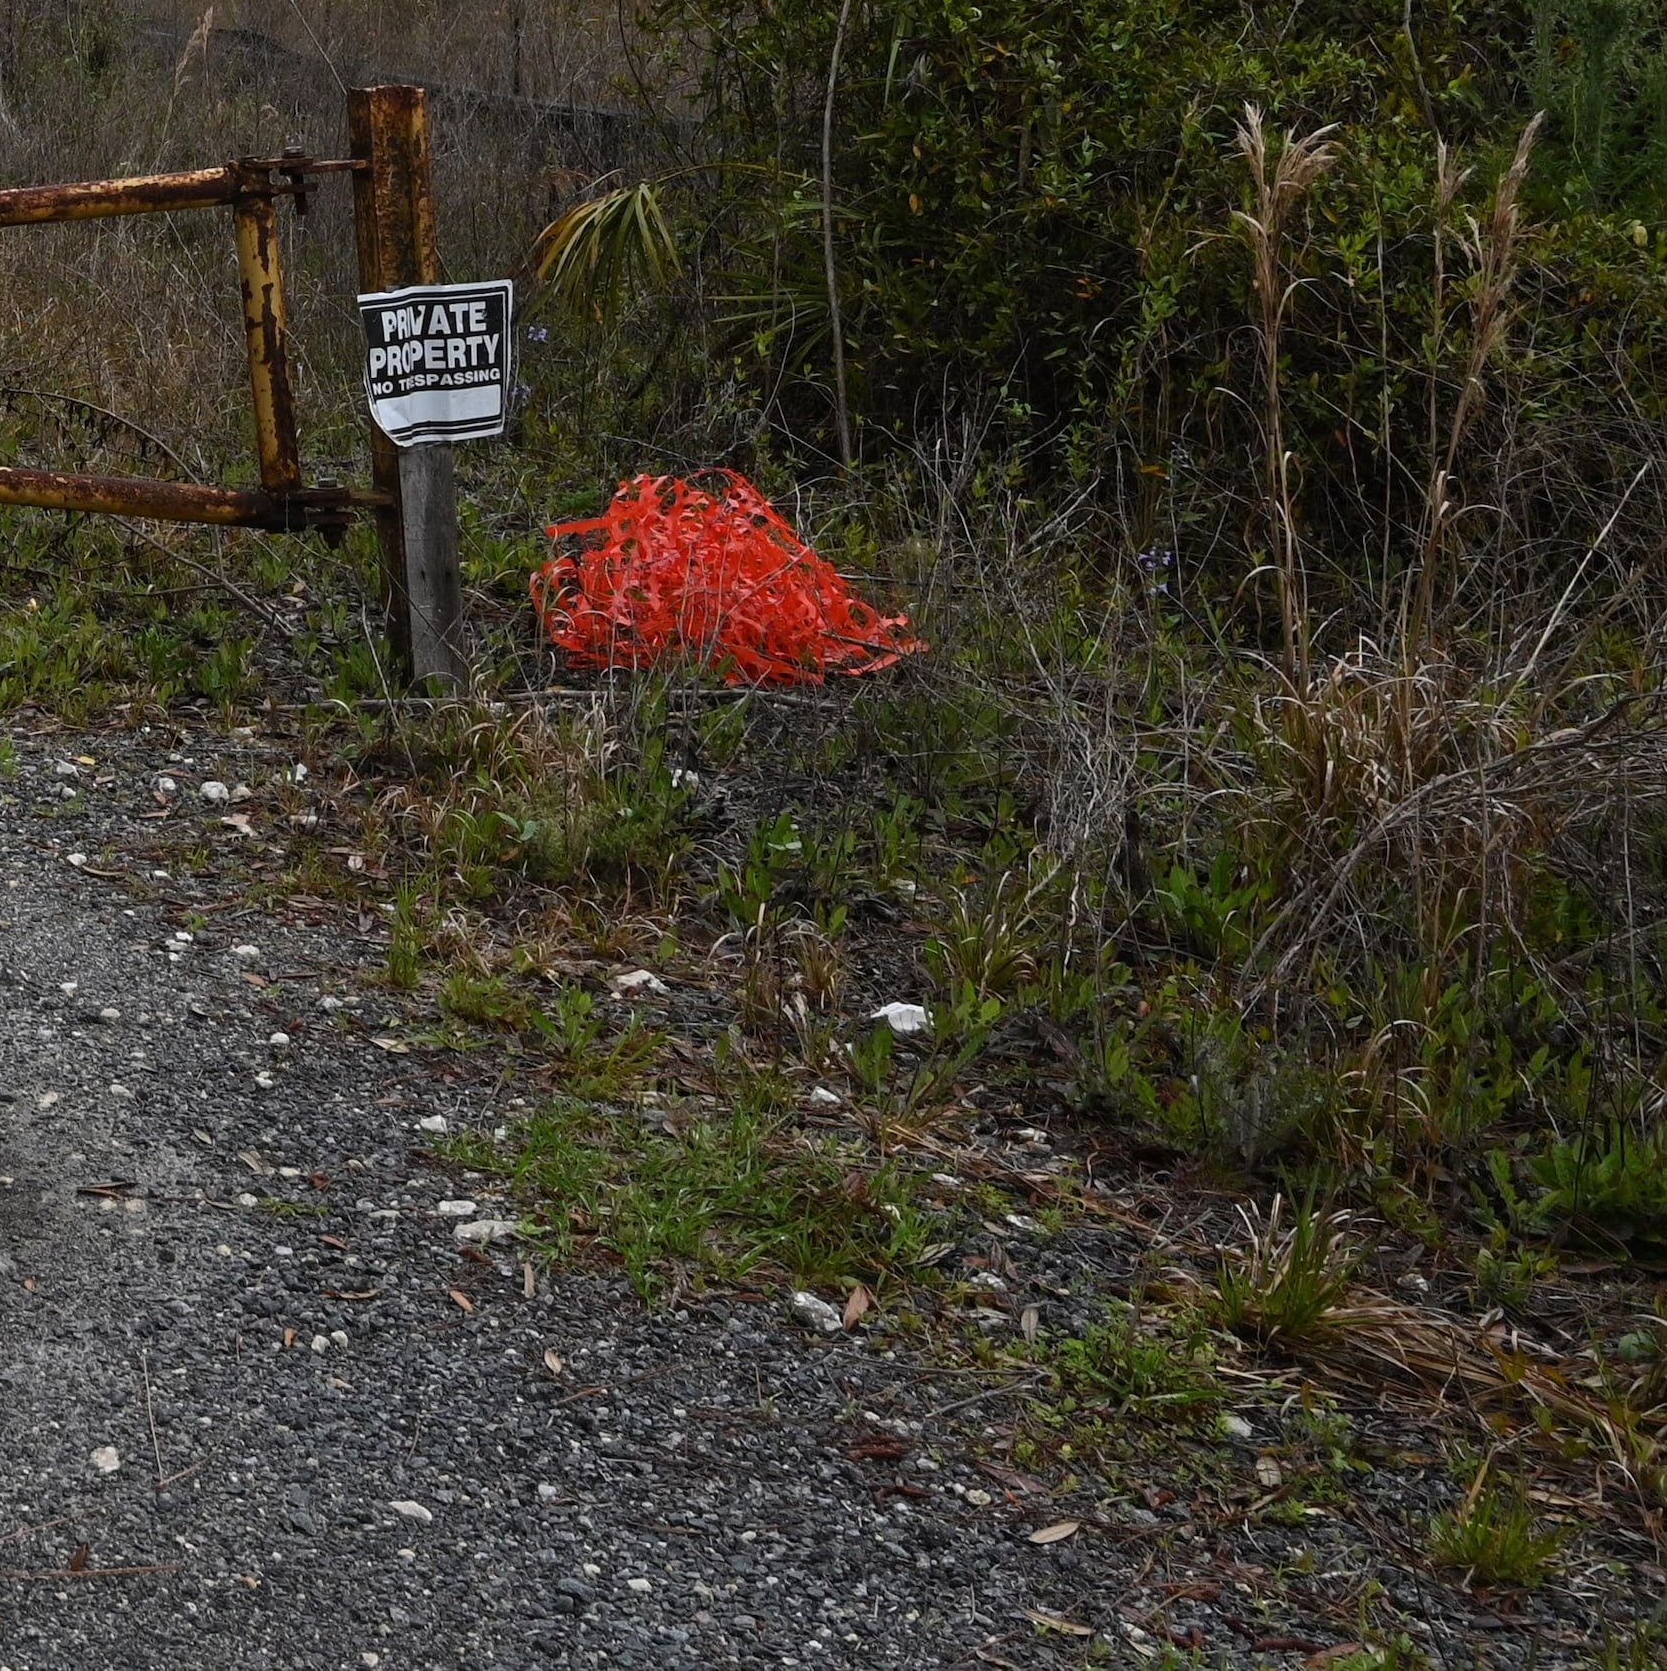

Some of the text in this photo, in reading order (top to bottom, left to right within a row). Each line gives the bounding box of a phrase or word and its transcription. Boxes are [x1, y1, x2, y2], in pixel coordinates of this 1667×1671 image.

[381, 301, 487, 342] PRIVATE
[369, 333, 500, 379] PROPERTY
[372, 381, 393, 395] NO
